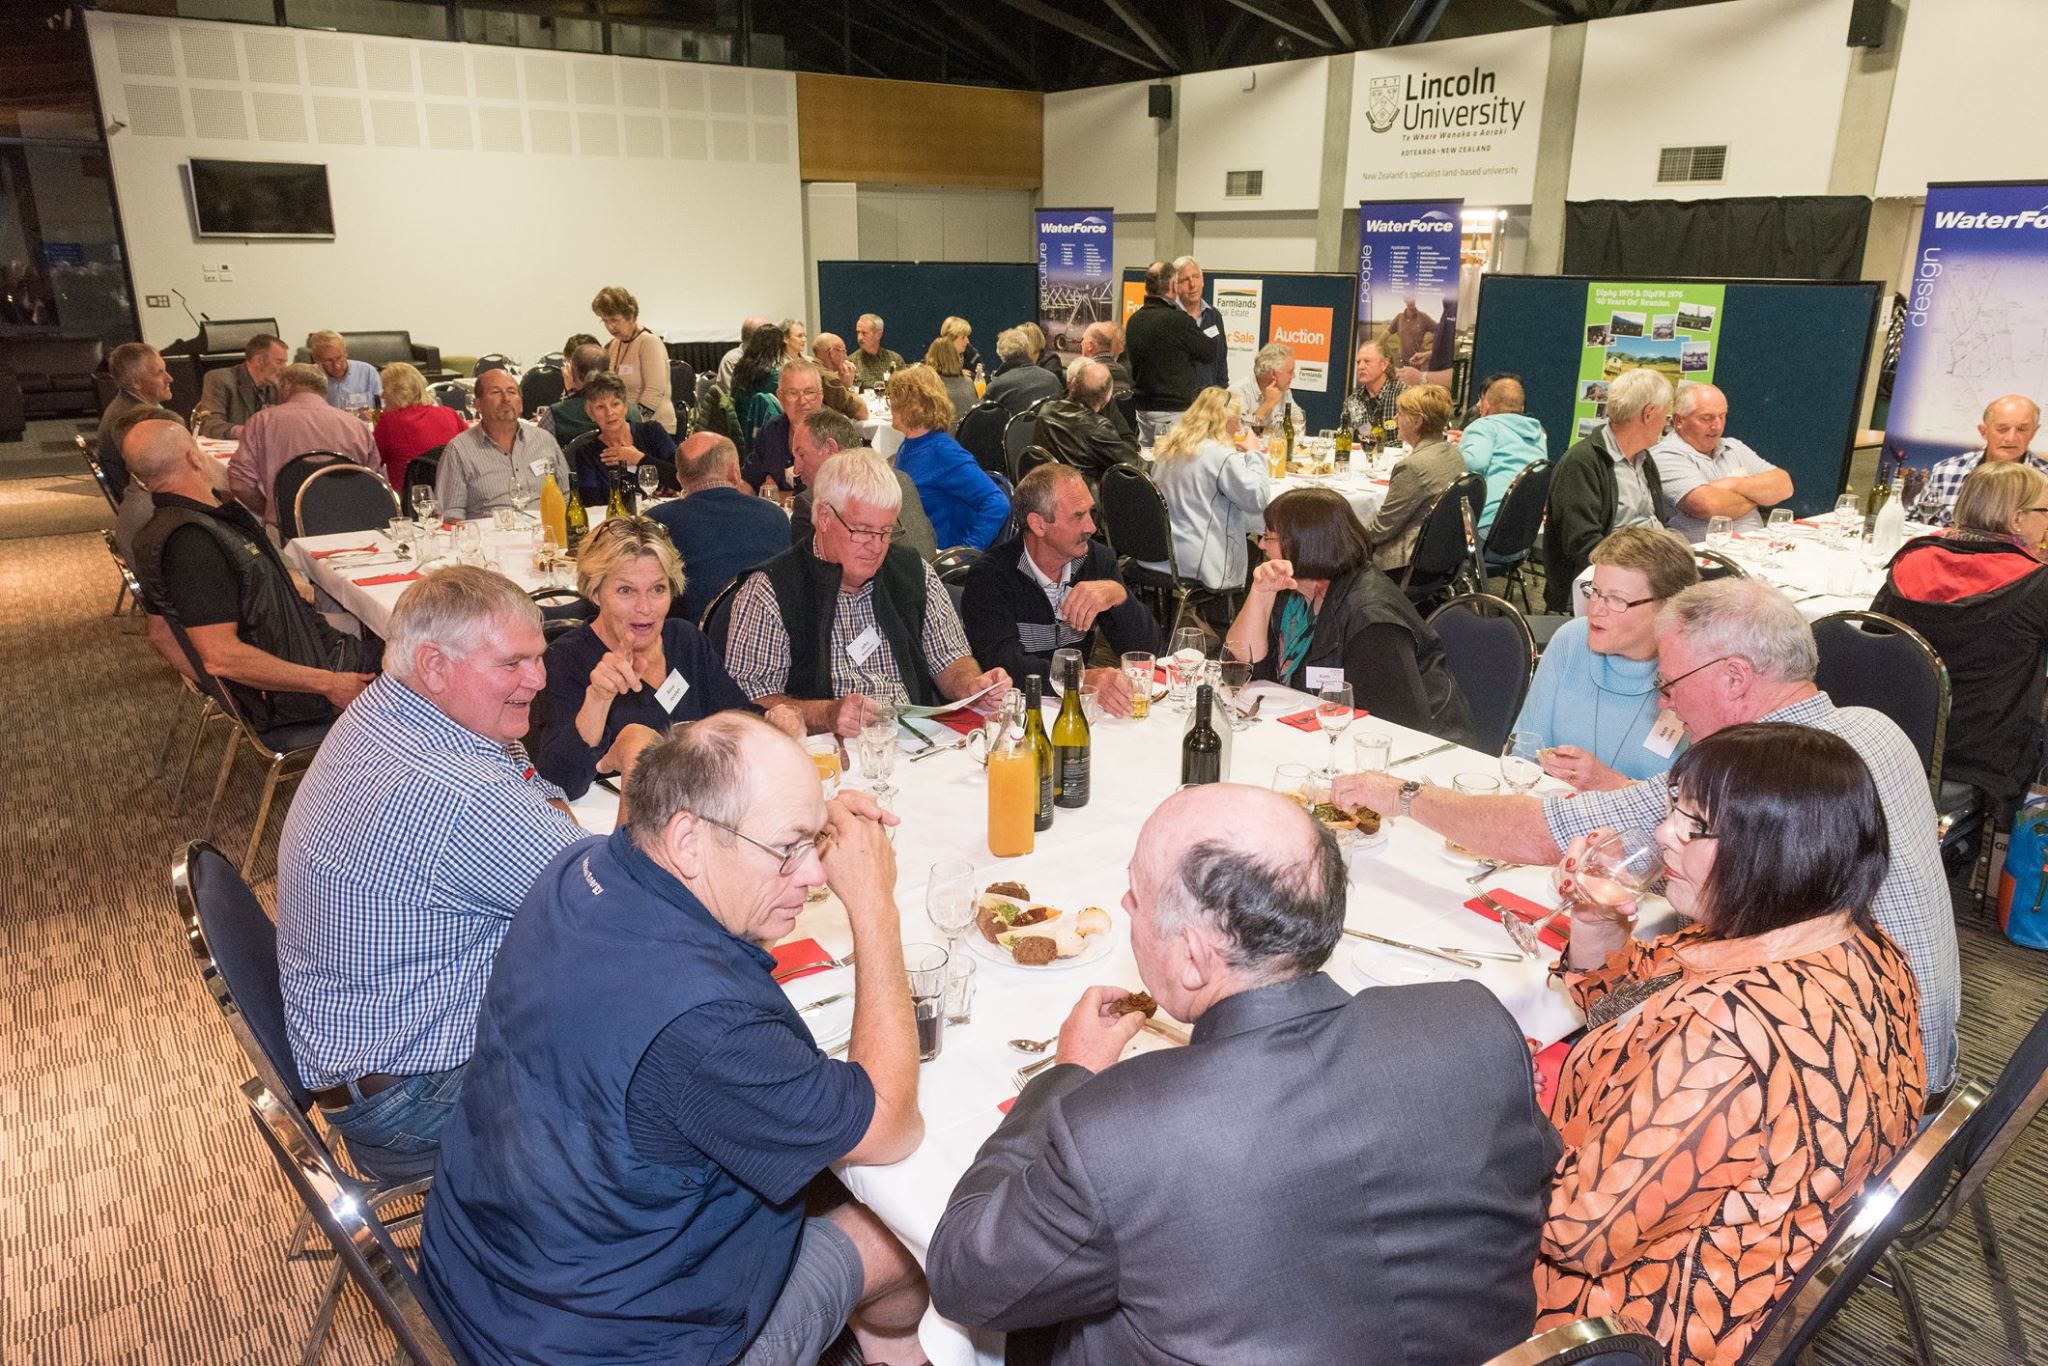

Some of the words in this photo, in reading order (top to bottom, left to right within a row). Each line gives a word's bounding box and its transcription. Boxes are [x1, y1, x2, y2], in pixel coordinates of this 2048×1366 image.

[1406, 66, 1496, 101] Lincoln
[1403, 96, 1526, 131] University
[1362, 171, 1376, 181] New
[1377, 169, 1409, 181] Zealand's
[1409, 168, 1441, 180] specialist
[1442, 166, 1481, 178] land-based
[1482, 165, 1519, 176] university
[1041, 222, 1107, 234] WaterForce
[1366, 219, 1453, 233] WaterForce
[1935, 210, 2048, 229] WaterFo
[1039, 242, 1048, 311] agriculture
[1360, 244, 1373, 303] people
[1911, 247, 1942, 327] design
[1217, 297, 1257, 309] Farmlands
[1233, 331, 1255, 345] Sale
[1274, 326, 1325, 345] Auction
